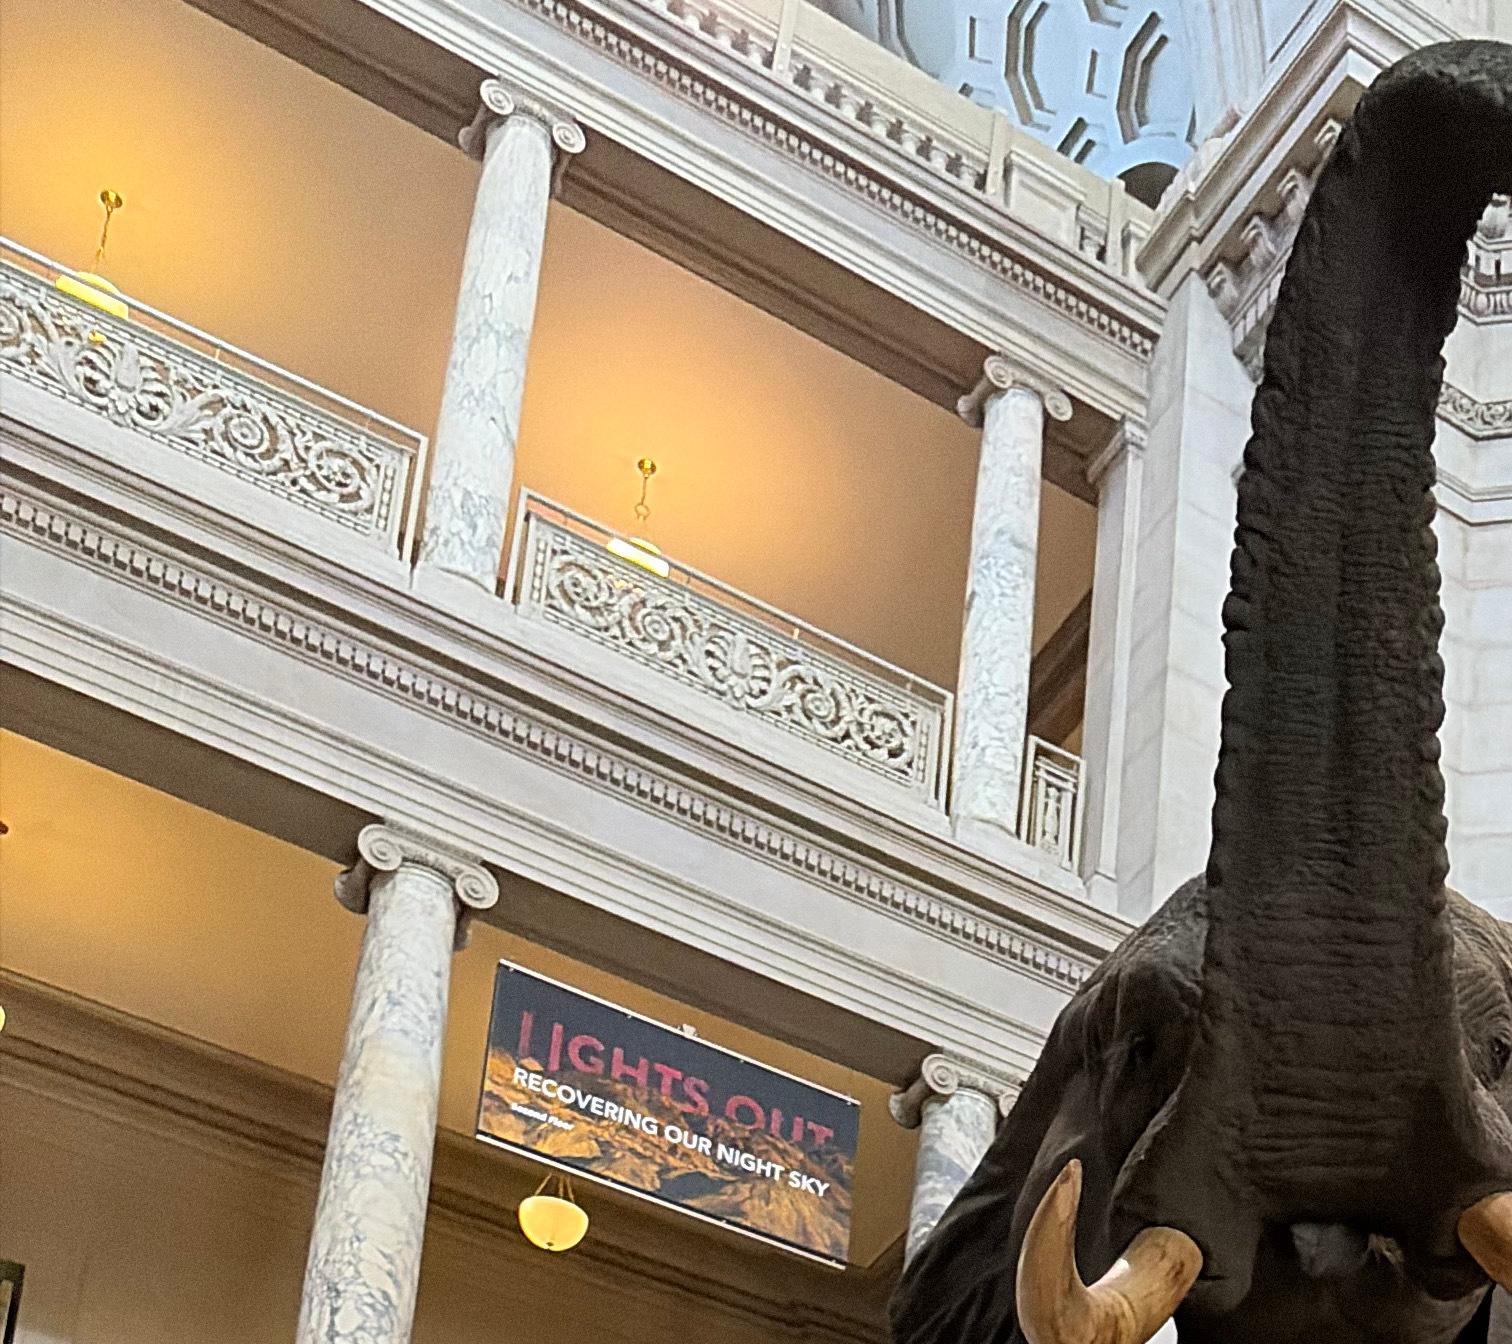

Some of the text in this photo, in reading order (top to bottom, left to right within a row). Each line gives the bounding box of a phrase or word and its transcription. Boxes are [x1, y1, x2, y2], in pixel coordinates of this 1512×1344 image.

[513, 1067, 830, 1197] RECOVERING OUR NIGHT SKY
[518, 1010, 834, 1147] LIGHTS OUT
